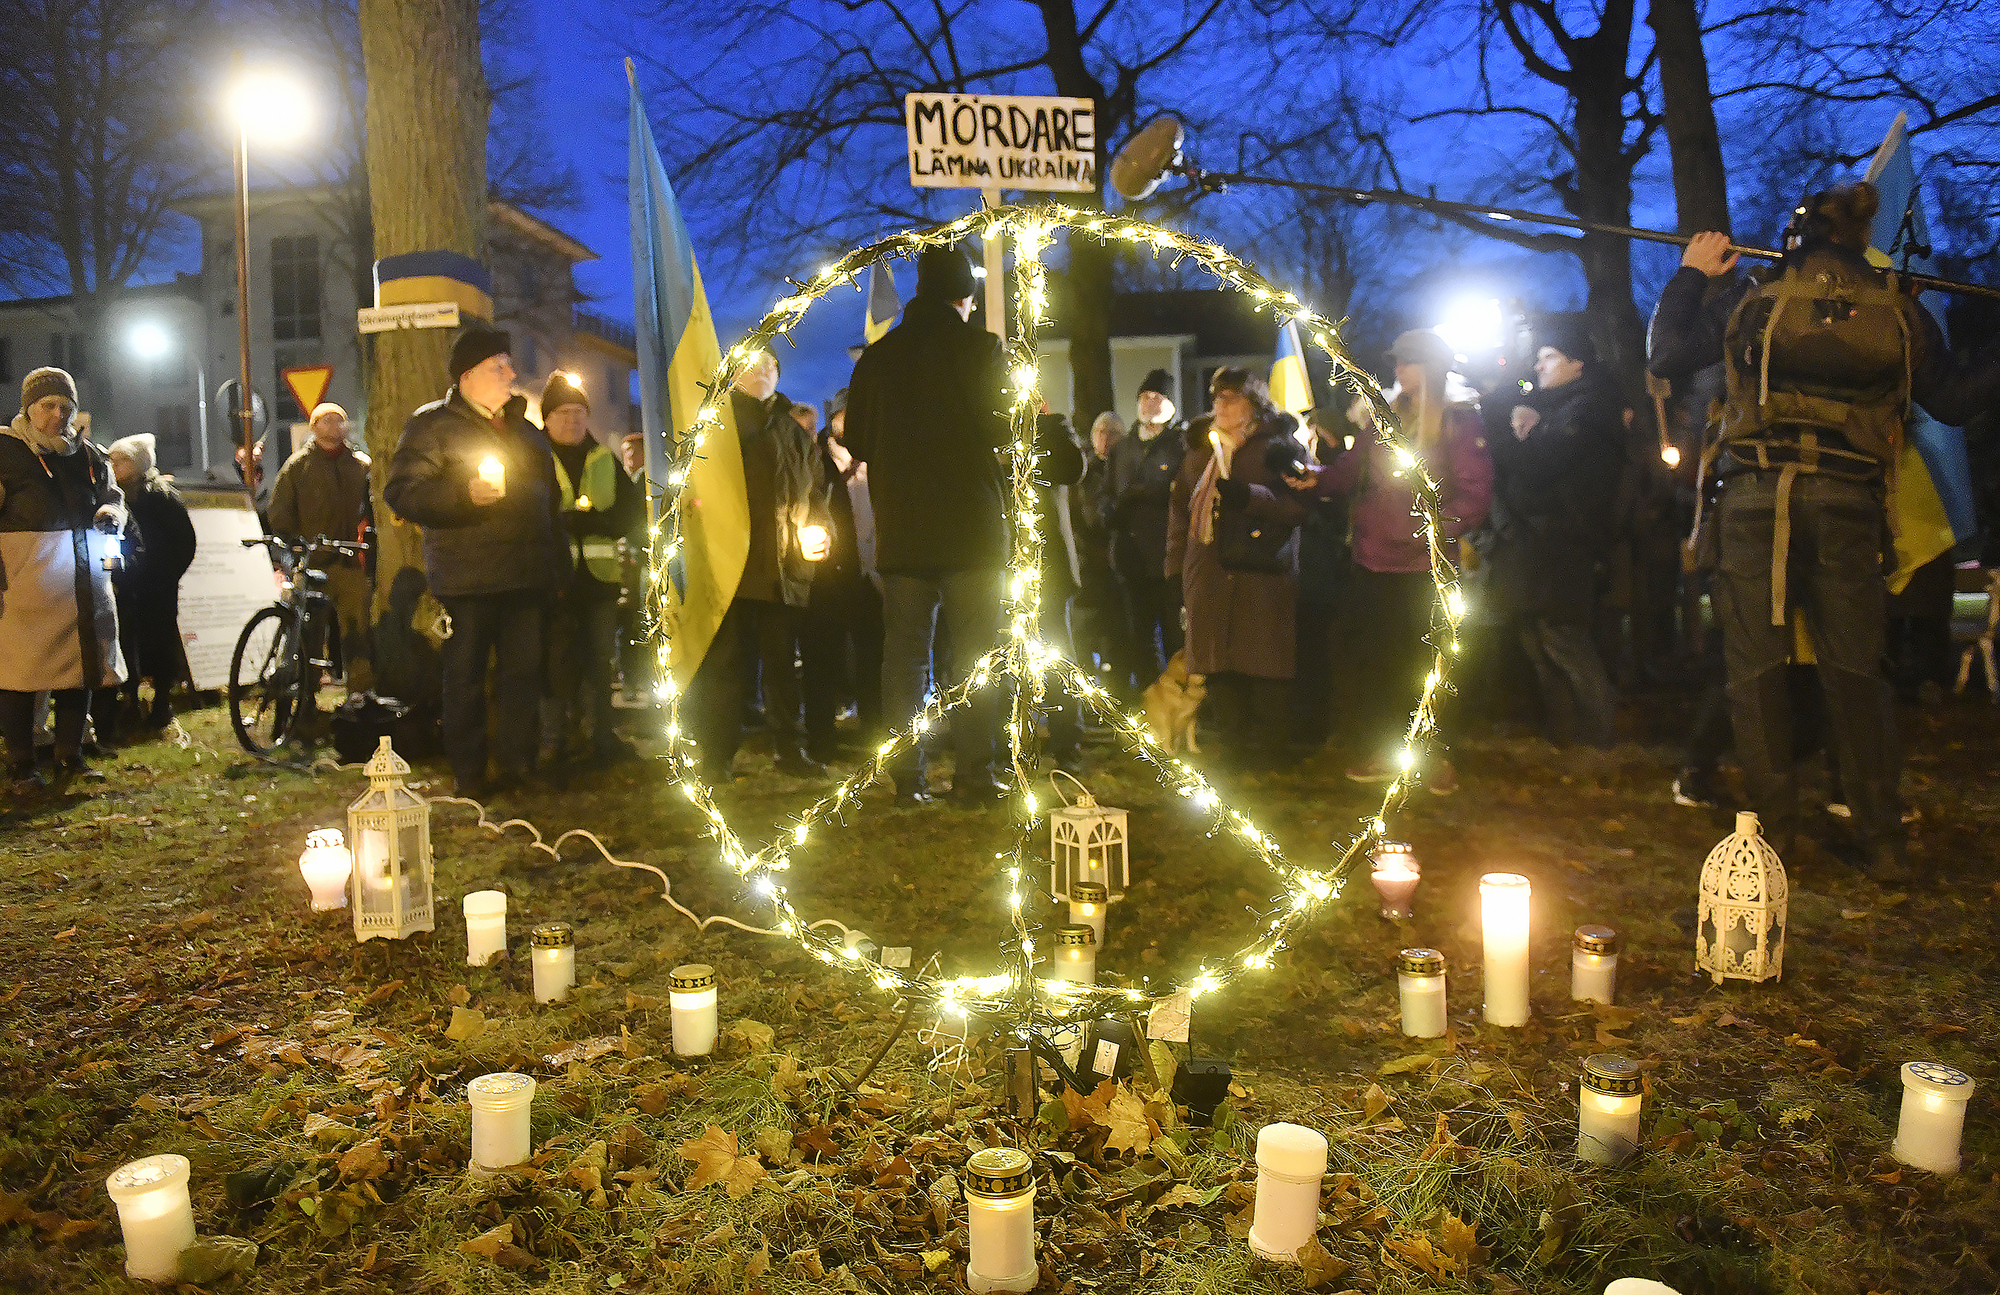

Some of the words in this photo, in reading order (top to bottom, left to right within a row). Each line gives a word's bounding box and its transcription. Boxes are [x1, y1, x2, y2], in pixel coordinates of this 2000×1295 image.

[914, 98, 1094, 152] MÖRDARE
[914, 149, 993, 178] LÄMNA
[998, 154, 1093, 183] UKRAINA
